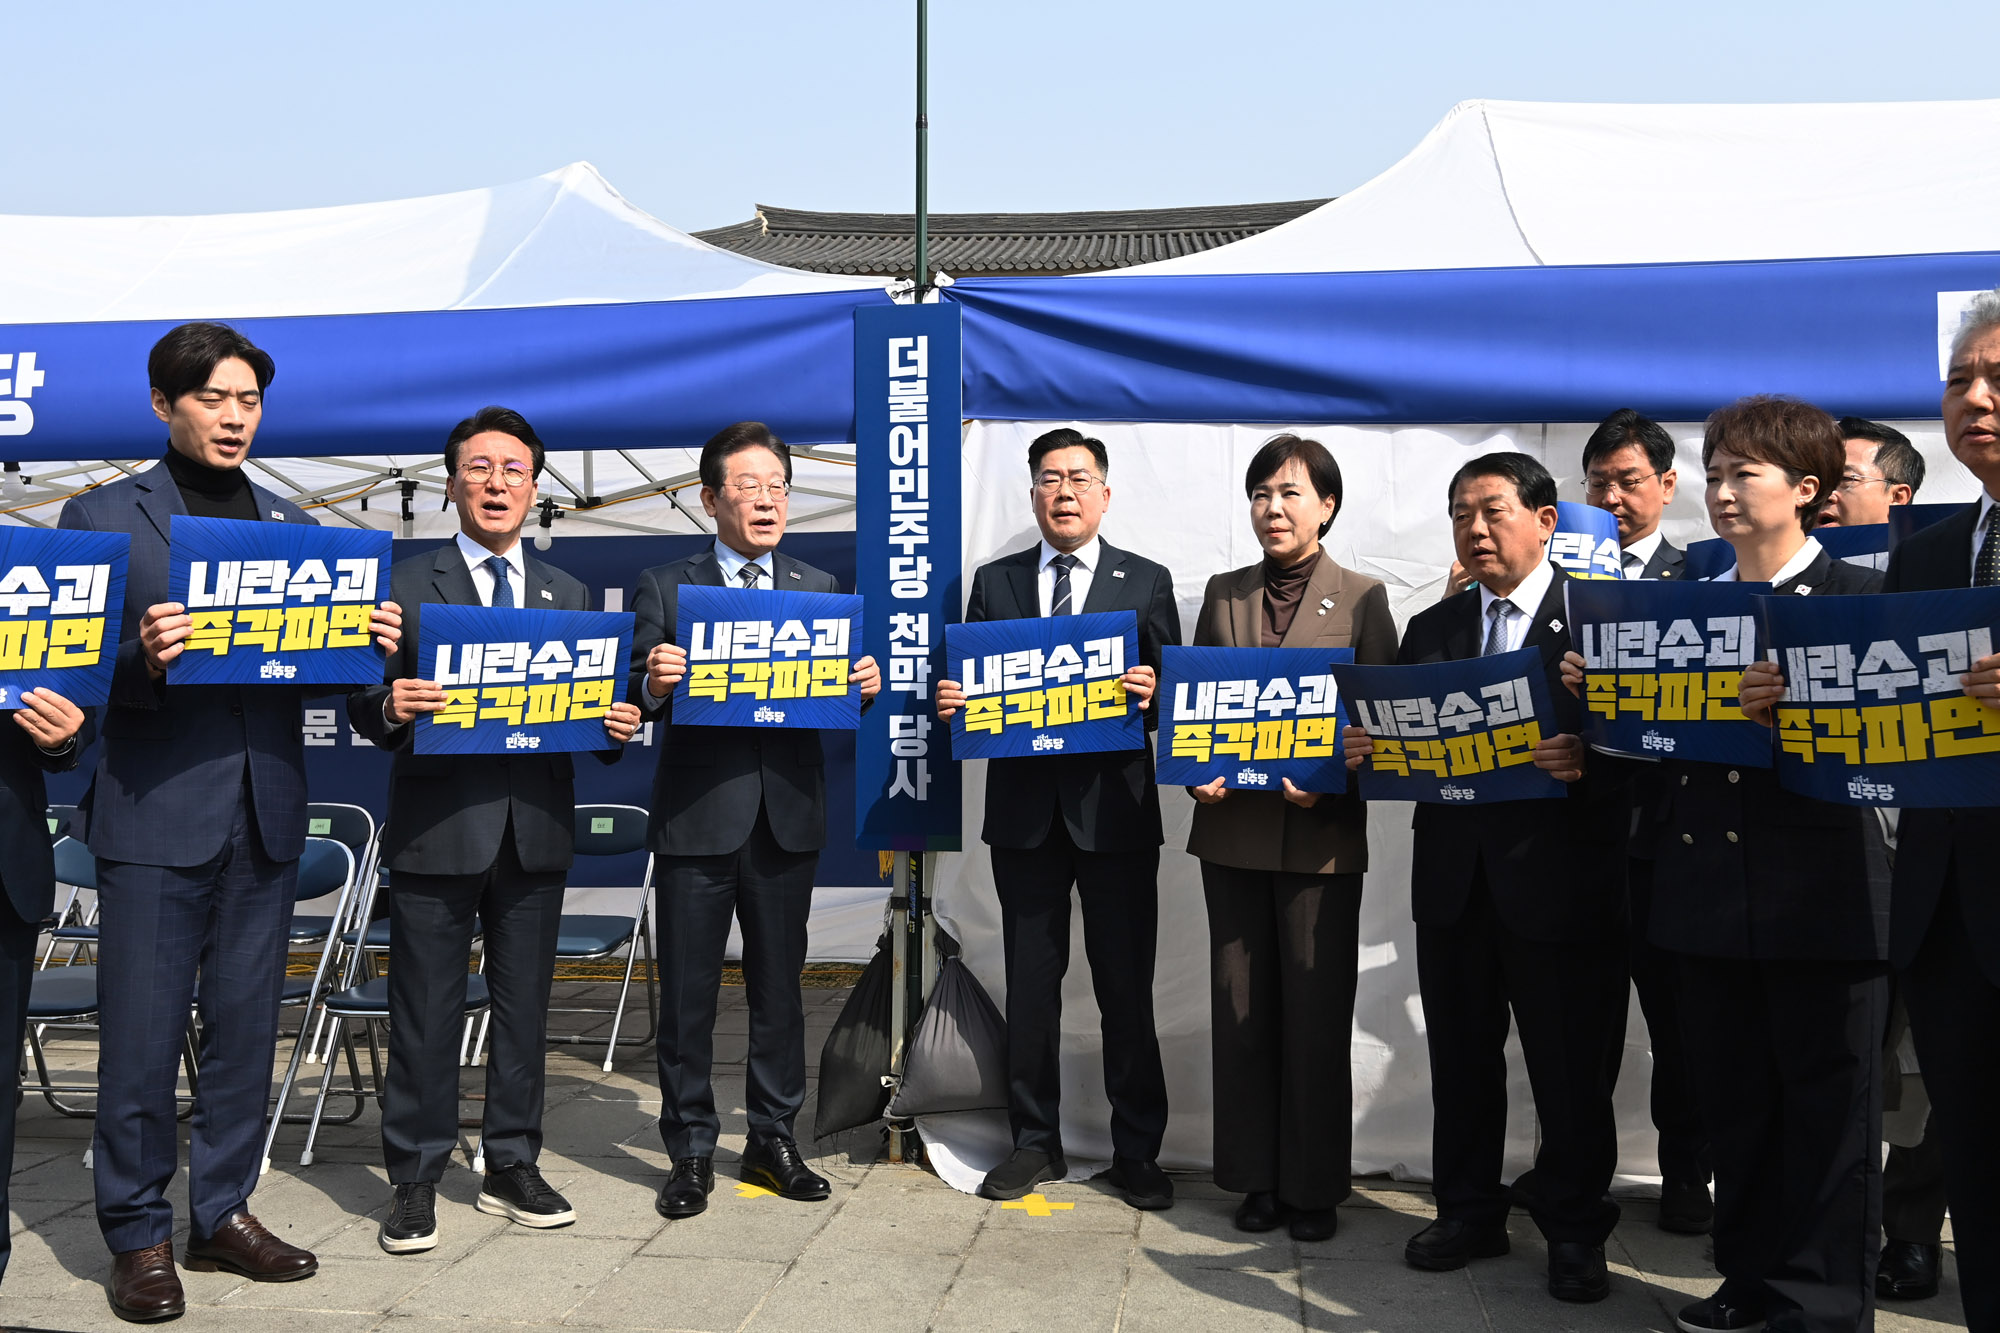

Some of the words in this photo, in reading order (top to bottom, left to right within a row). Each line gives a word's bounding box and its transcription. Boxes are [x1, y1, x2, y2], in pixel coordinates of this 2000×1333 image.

[888, 335, 932, 599] 더불어민주당
[187, 557, 379, 608] 내란수괴
[183, 604, 376, 656] 즉각파면
[690, 618, 851, 661] 내란수괴
[1582, 615, 1756, 669] 내란수괴
[260, 665, 298, 679] 민주당
[433, 637, 620, 686] 내란수괴
[688, 658, 850, 702] 즉각파면
[888, 612, 932, 700] 천막
[962, 635, 1125, 697] 내란수괴
[1767, 627, 1994, 702] 내란수괴
[432, 678, 615, 729] 즉각파면
[754, 710, 785, 723] 민주당
[964, 678, 1128, 735] 즉각파면
[1173, 674, 1338, 721] 내란수괴
[1355, 676, 1535, 737] 내란수괴
[1585, 671, 1752, 721] 즉각파면
[505, 736, 541, 749] 민주당
[1032, 737, 1065, 751] 민주당
[1171, 717, 1336, 763] 즉각파면
[1371, 720, 1542, 778] 즉각파면
[1641, 735, 1676, 752] 민주당
[1777, 696, 2000, 765] 즉각파면
[888, 714, 932, 801] 당사
[1237, 772, 1269, 785] 민주당
[1440, 788, 1476, 801] 민주당
[1847, 781, 1895, 801] 민주당
